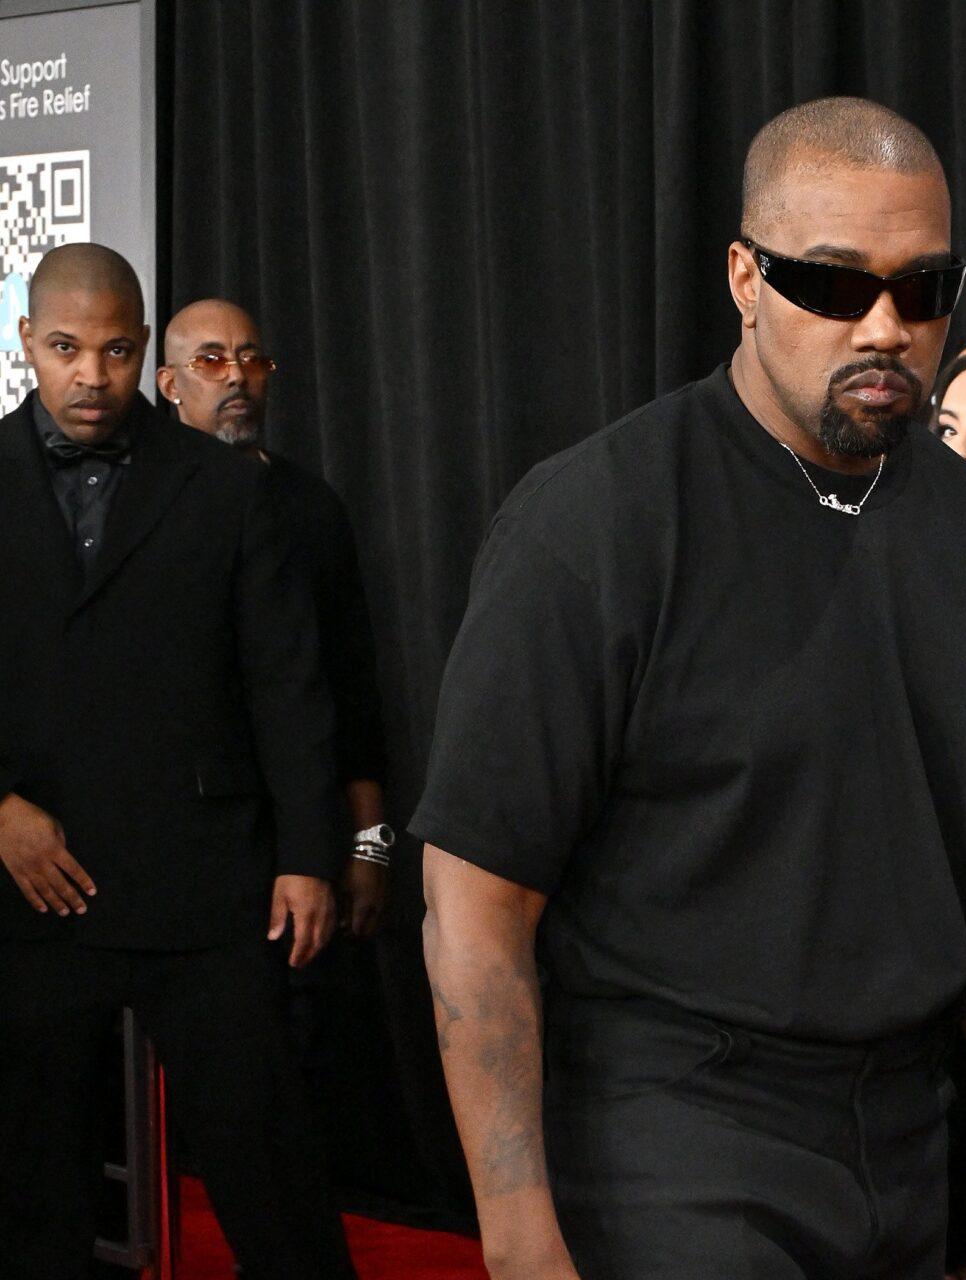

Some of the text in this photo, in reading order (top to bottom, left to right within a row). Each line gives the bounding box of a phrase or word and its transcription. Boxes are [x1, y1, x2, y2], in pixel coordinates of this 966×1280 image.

[0, 52, 67, 90] Support
[10, 92, 39, 119] Fire
[43, 84, 91, 115] Relief
